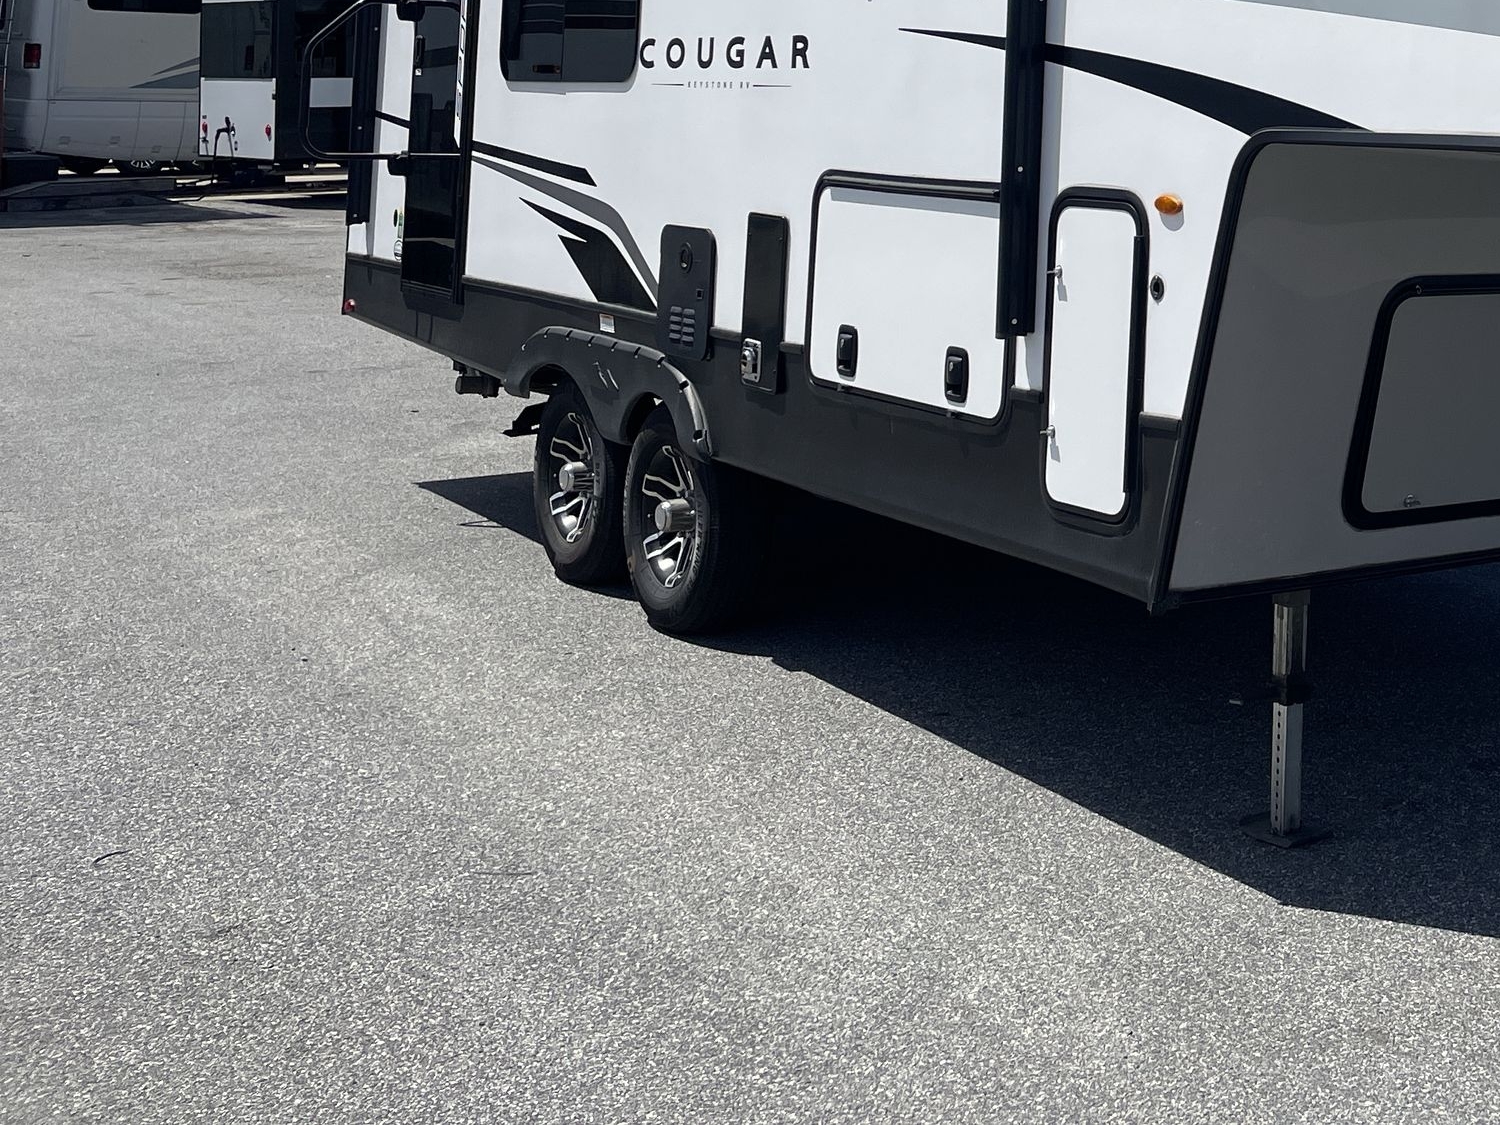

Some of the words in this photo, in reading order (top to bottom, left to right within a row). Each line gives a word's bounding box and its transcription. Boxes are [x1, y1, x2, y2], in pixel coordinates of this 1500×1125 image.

[639, 34, 810, 70] COUGAR
[687, 80, 733, 89] KEYSTONE
[740, 81, 750, 89] RV
